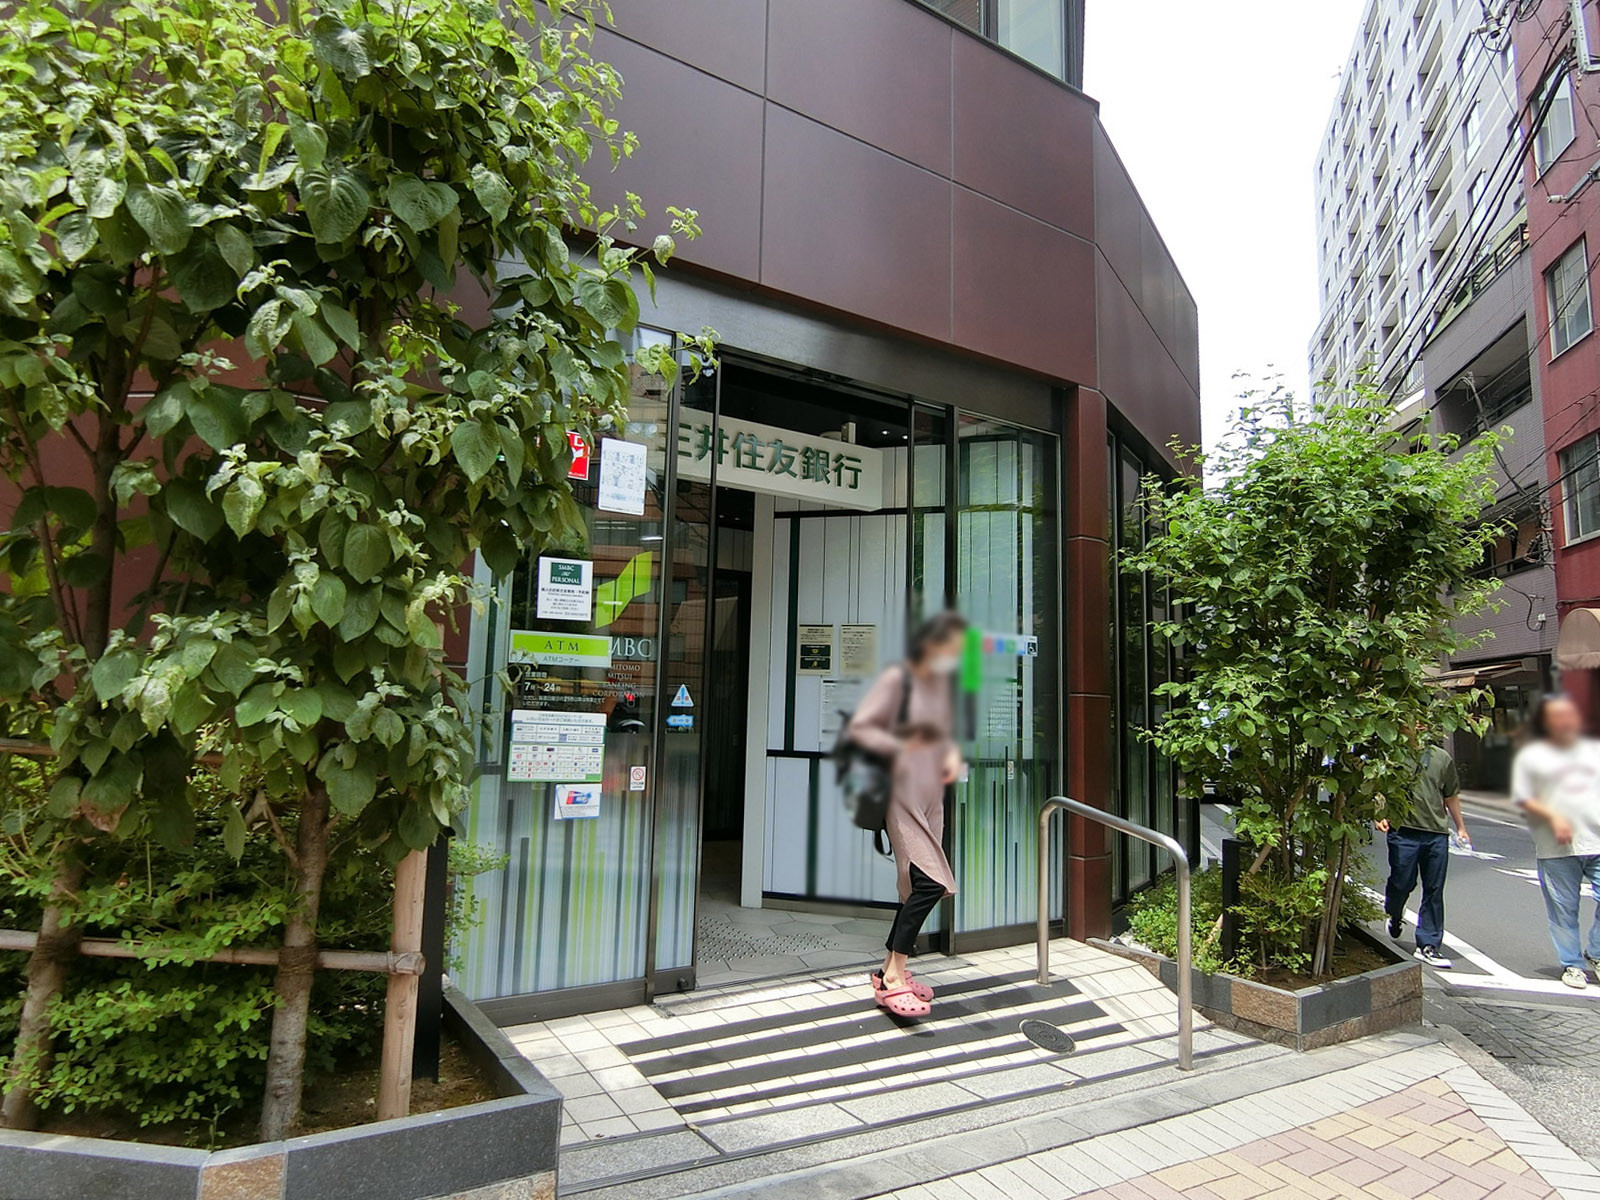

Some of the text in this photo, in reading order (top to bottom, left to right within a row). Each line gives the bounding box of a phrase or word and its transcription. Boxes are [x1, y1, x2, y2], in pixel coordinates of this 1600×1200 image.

[656, 418, 862, 490] 三井住友銀行
[558, 564, 575, 572] SMBC
[551, 576, 580, 584] PERSONAL
[544, 640, 580, 651] ATM
[543, 655, 581, 663] ATMコーナー
